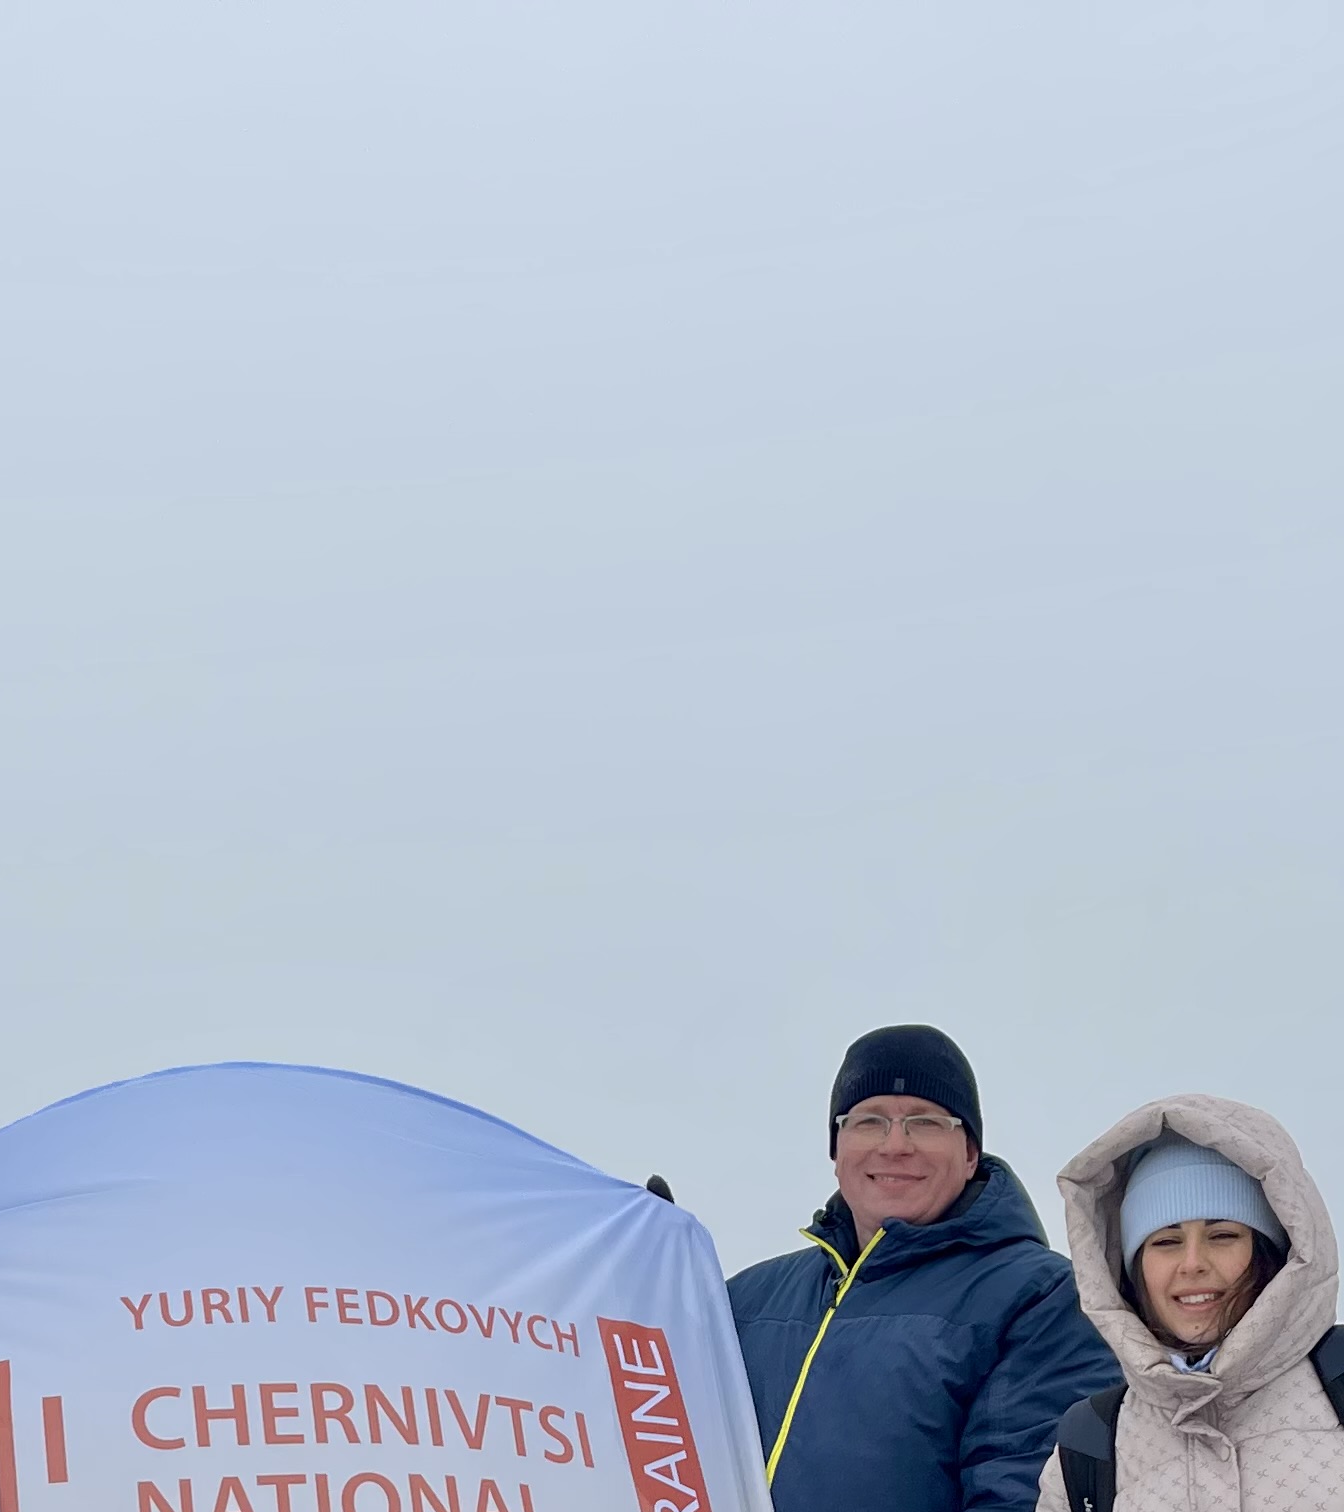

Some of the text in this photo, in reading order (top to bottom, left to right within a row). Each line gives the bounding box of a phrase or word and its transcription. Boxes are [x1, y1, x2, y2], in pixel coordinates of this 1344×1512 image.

[122, 1286, 579, 1356] YURIY FEDKOVYCH
[131, 1382, 595, 1468] CHERNIVTSI
